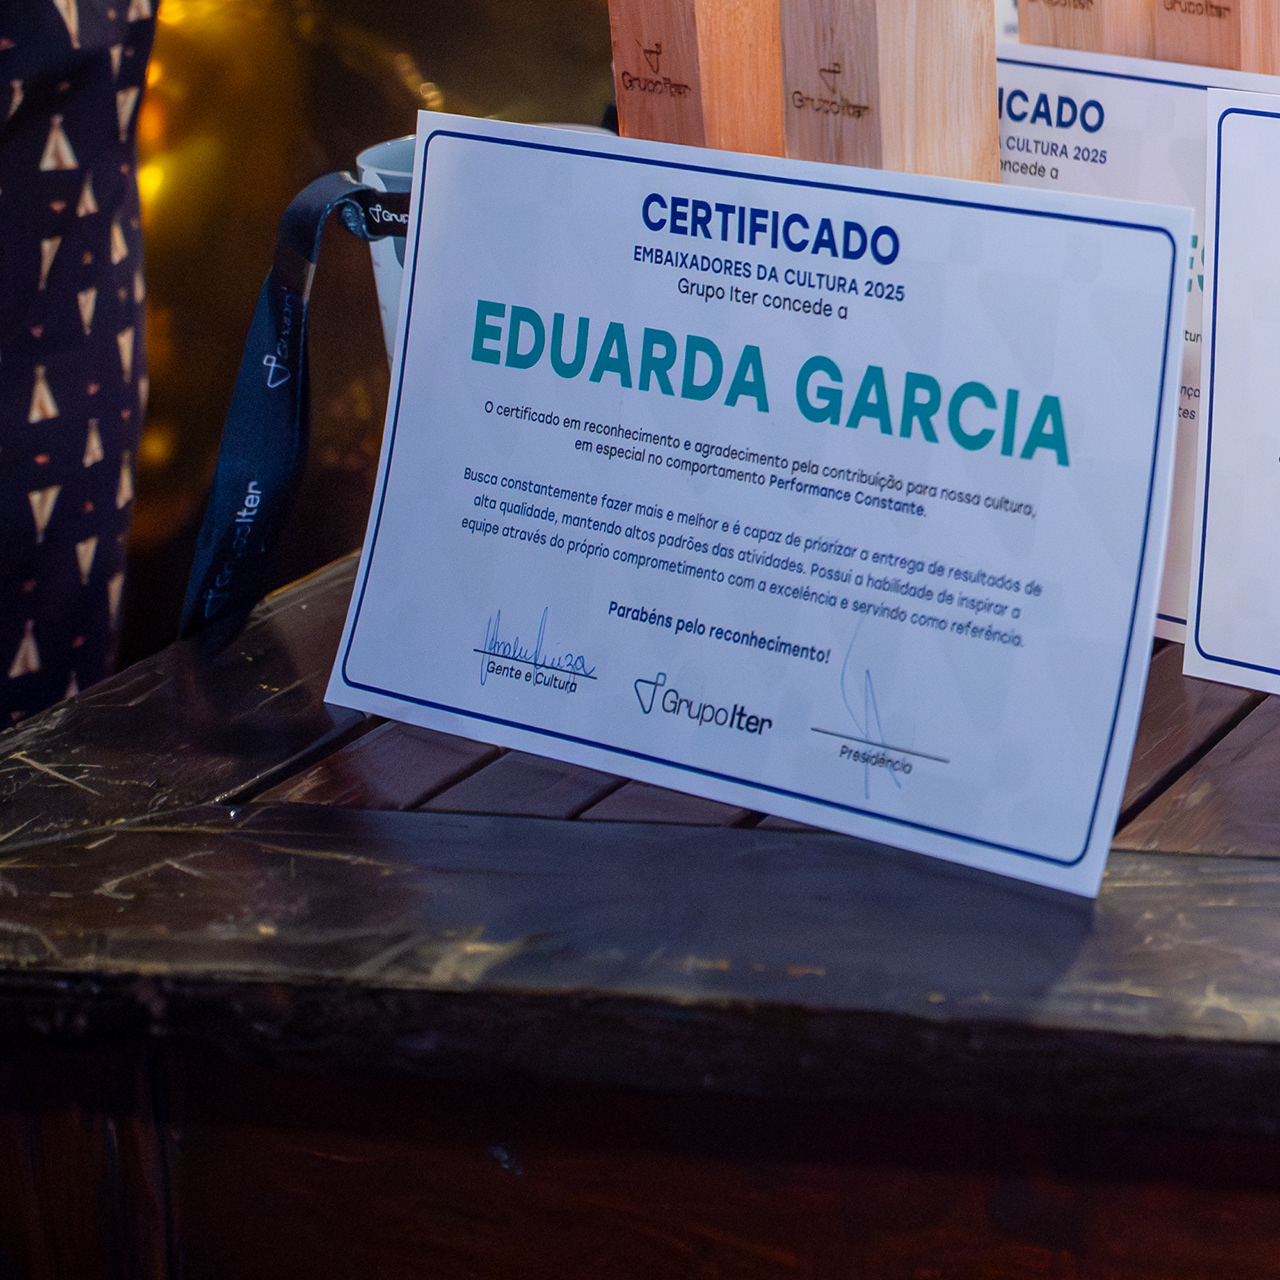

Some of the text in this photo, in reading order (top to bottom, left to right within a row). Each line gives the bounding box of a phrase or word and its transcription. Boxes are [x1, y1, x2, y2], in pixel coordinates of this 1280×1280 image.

[1006, 136, 1108, 165] CULTURA 2025
[1050, 166, 1060, 180] a
[641, 192, 900, 266] CERTIFICADO
[633, 245, 905, 302] EMBAIXADORES DA CULTURA 2025
[677, 277, 848, 320] Grupo Iter concede a
[470, 298, 1070, 468] EDUARDA GARCIA
[484, 400, 789, 470] O certificado em reconhecimento e agradecimento
[574, 439, 766, 486] em especial no comportamento
[463, 467, 663, 519] Busca constantemente fazer mais
[461, 517, 610, 559] equipe através próprio
[473, 493, 709, 554] alta qualidade, mantendo altos padrões
[607, 600, 831, 664] Parabéns pelo reconhecimento!
[485, 659, 578, 694] Gente e Cultura
[839, 744, 913, 775] Presidência
